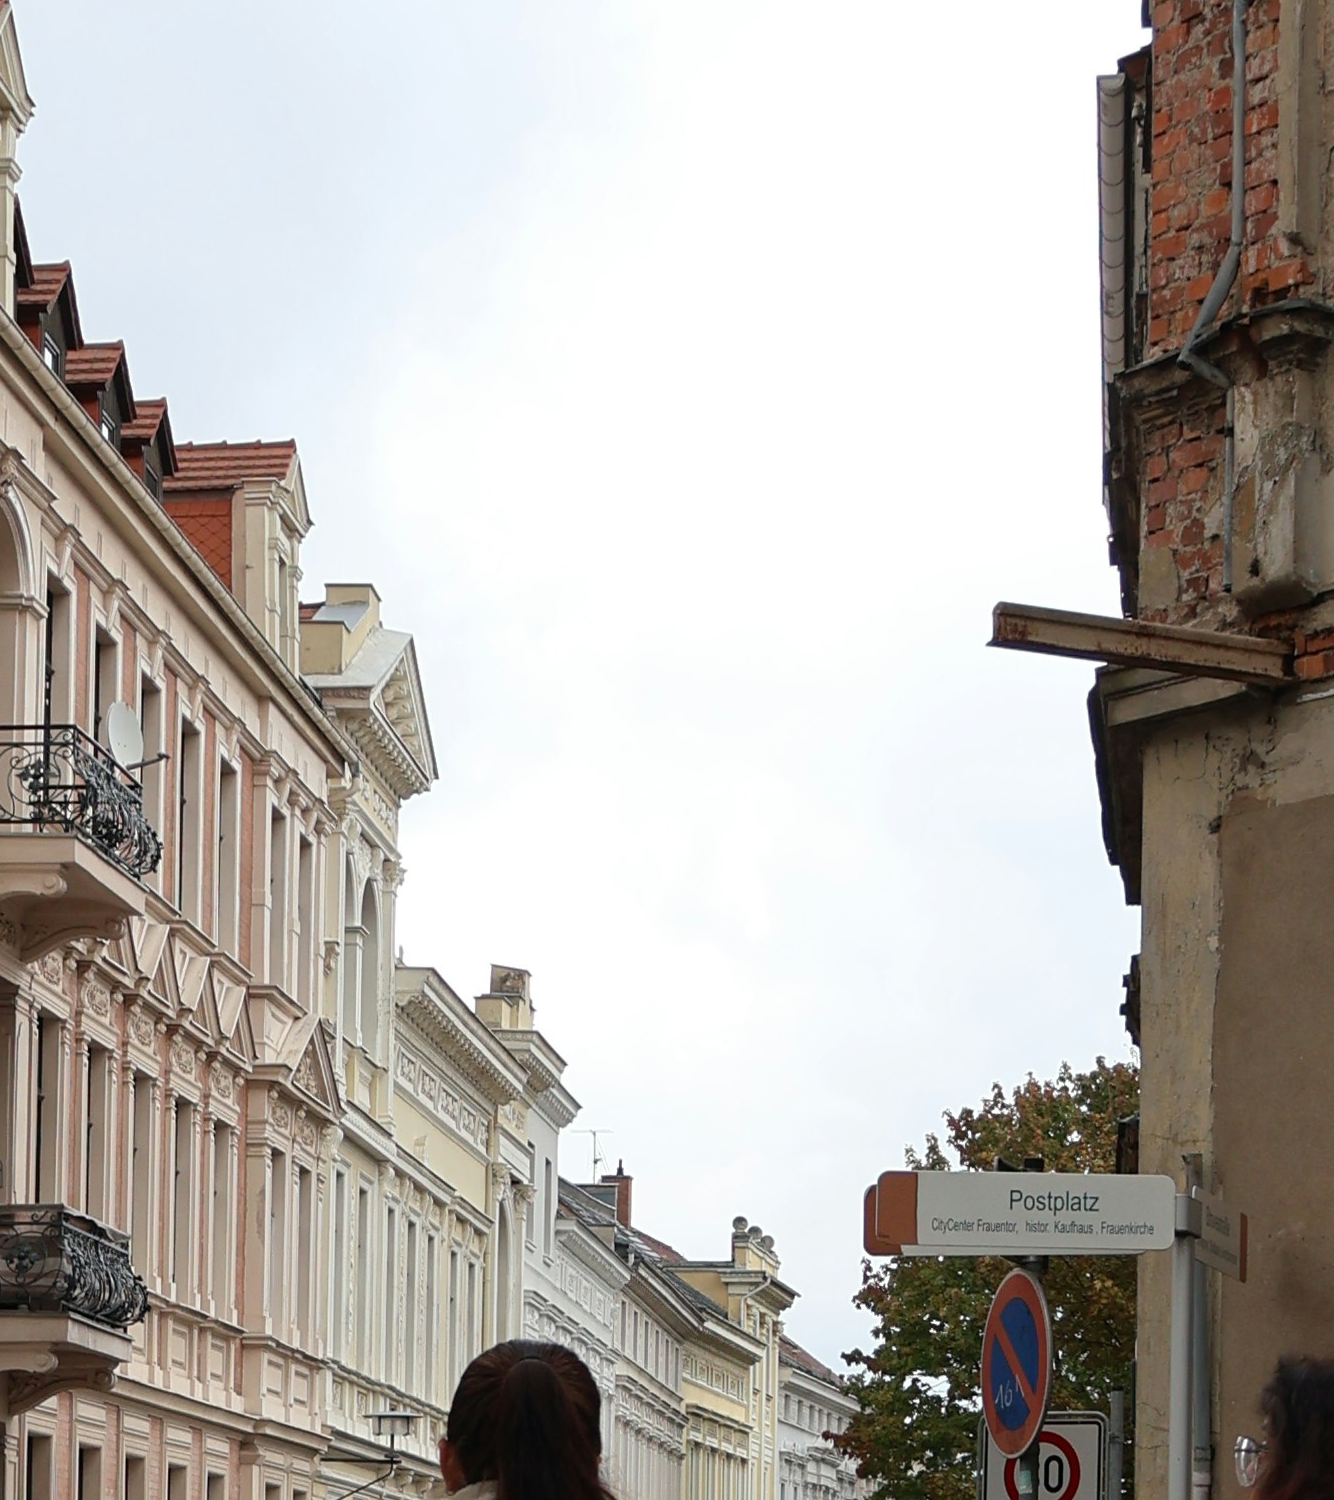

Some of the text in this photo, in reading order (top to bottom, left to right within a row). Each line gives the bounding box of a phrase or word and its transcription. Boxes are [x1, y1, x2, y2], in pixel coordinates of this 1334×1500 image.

[1009, 1189, 1100, 1216] Postplatz
[931, 1217, 975, 1234] CityCenter
[977, 1218, 1019, 1235] Frauentor,
[1025, 1220, 1049, 1233] histor.
[1101, 1221, 1154, 1235] Frauenkirche
